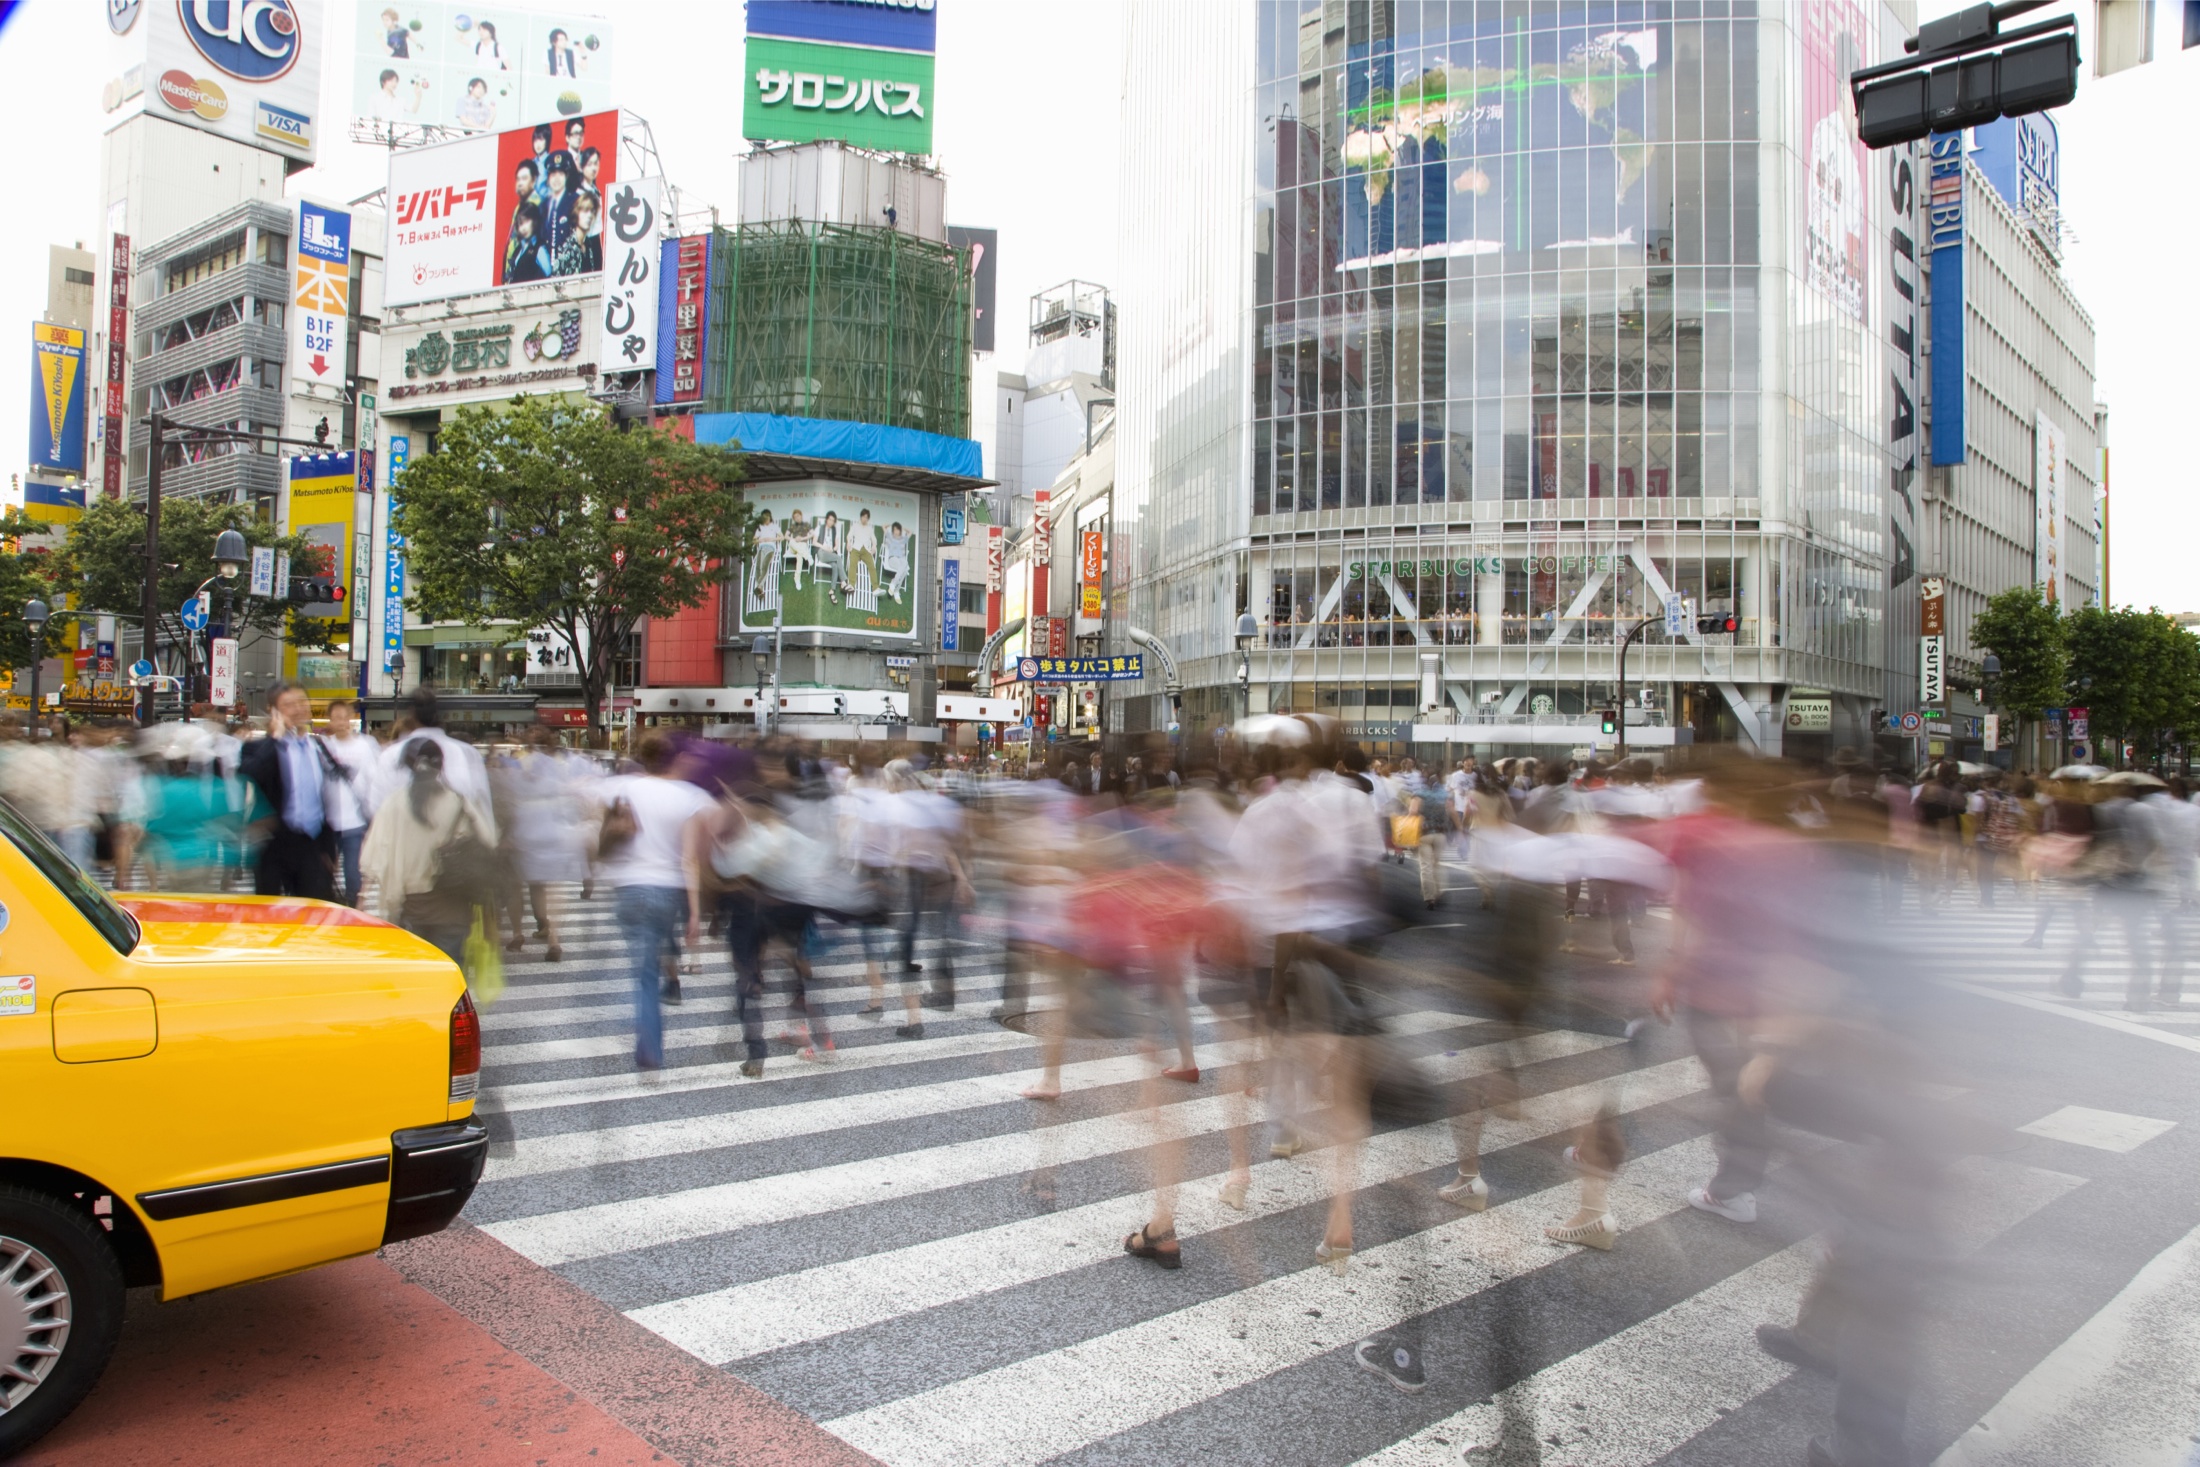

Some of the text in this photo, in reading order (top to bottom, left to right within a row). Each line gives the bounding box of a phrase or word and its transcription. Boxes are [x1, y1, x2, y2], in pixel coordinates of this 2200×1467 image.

[160, 79, 227, 110] MasterCard
[756, 68, 924, 118] サロンパス
[267, 113, 301, 135] VISA
[2018, 118, 2058, 192] SEIBU
[396, 179, 487, 225] シバトラ
[1931, 136, 1961, 253] SEIBU
[302, 242, 345, 258] ブックファースト
[296, 259, 349, 312] 本
[428, 267, 460, 279] フジテレビ
[605, 185, 654, 363] もんじゃ
[306, 315, 334, 335] B1F
[674, 241, 700, 391] 三千里薬品
[50, 326, 69, 344] 薬
[305, 334, 333, 353] B2F
[452, 336, 511, 373] 西村
[1890, 143, 1914, 590] SUTAYA
[50, 355, 64, 462] Matsumoto KiYoshi
[293, 486, 333, 498] Matsumoto
[1034, 500, 1049, 568] さくらや
[259, 551, 272, 592] 渋谷駅前
[988, 534, 1002, 594] さくらや
[1349, 554, 1626, 580] STARBUCKS COFFEE
[945, 565, 957, 644] 大盛堂商事ビル
[1672, 596, 1680, 632] 渋谷駅前
[1928, 602, 1938, 629] ぶん楽
[100, 658, 113, 673] 本
[214, 645, 227, 699] 道玄坂
[537, 645, 570, 667] 松川
[1040, 657, 1140, 673] 歩きタバコ禁止
[1926, 636, 1939, 701] TSUTAYA
[64, 679, 134, 700] グルメタウン
[1789, 704, 1830, 712] TSUTAYA
